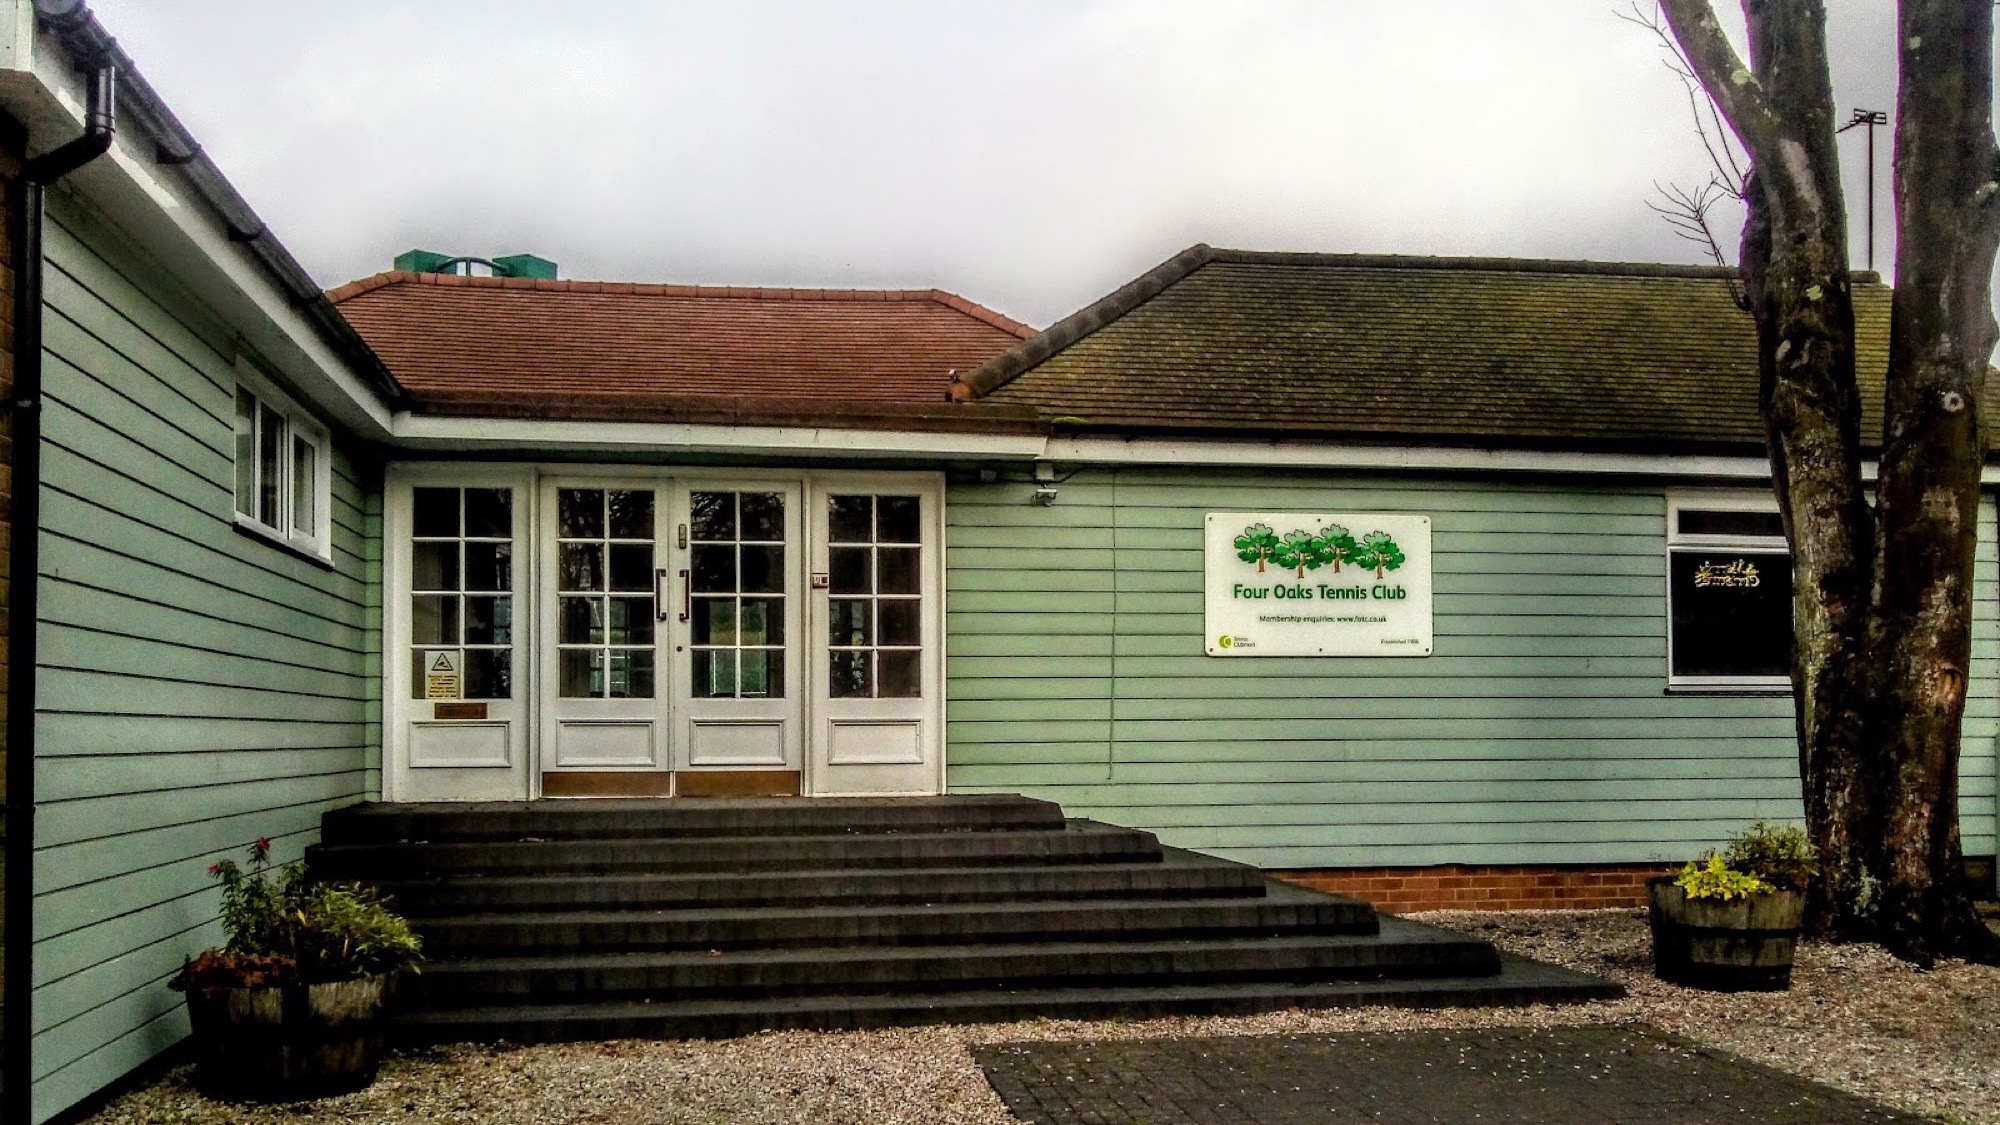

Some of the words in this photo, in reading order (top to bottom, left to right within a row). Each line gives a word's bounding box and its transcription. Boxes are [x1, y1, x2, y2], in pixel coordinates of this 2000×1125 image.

[1233, 583, 1270, 600] Four
[1273, 583, 1314, 600] Oaks
[1316, 584, 1368, 600] Tennis
[1371, 585, 1407, 601] Club
[1259, 615, 1302, 624] Membership
[1303, 615, 1336, 624] enquiries:
